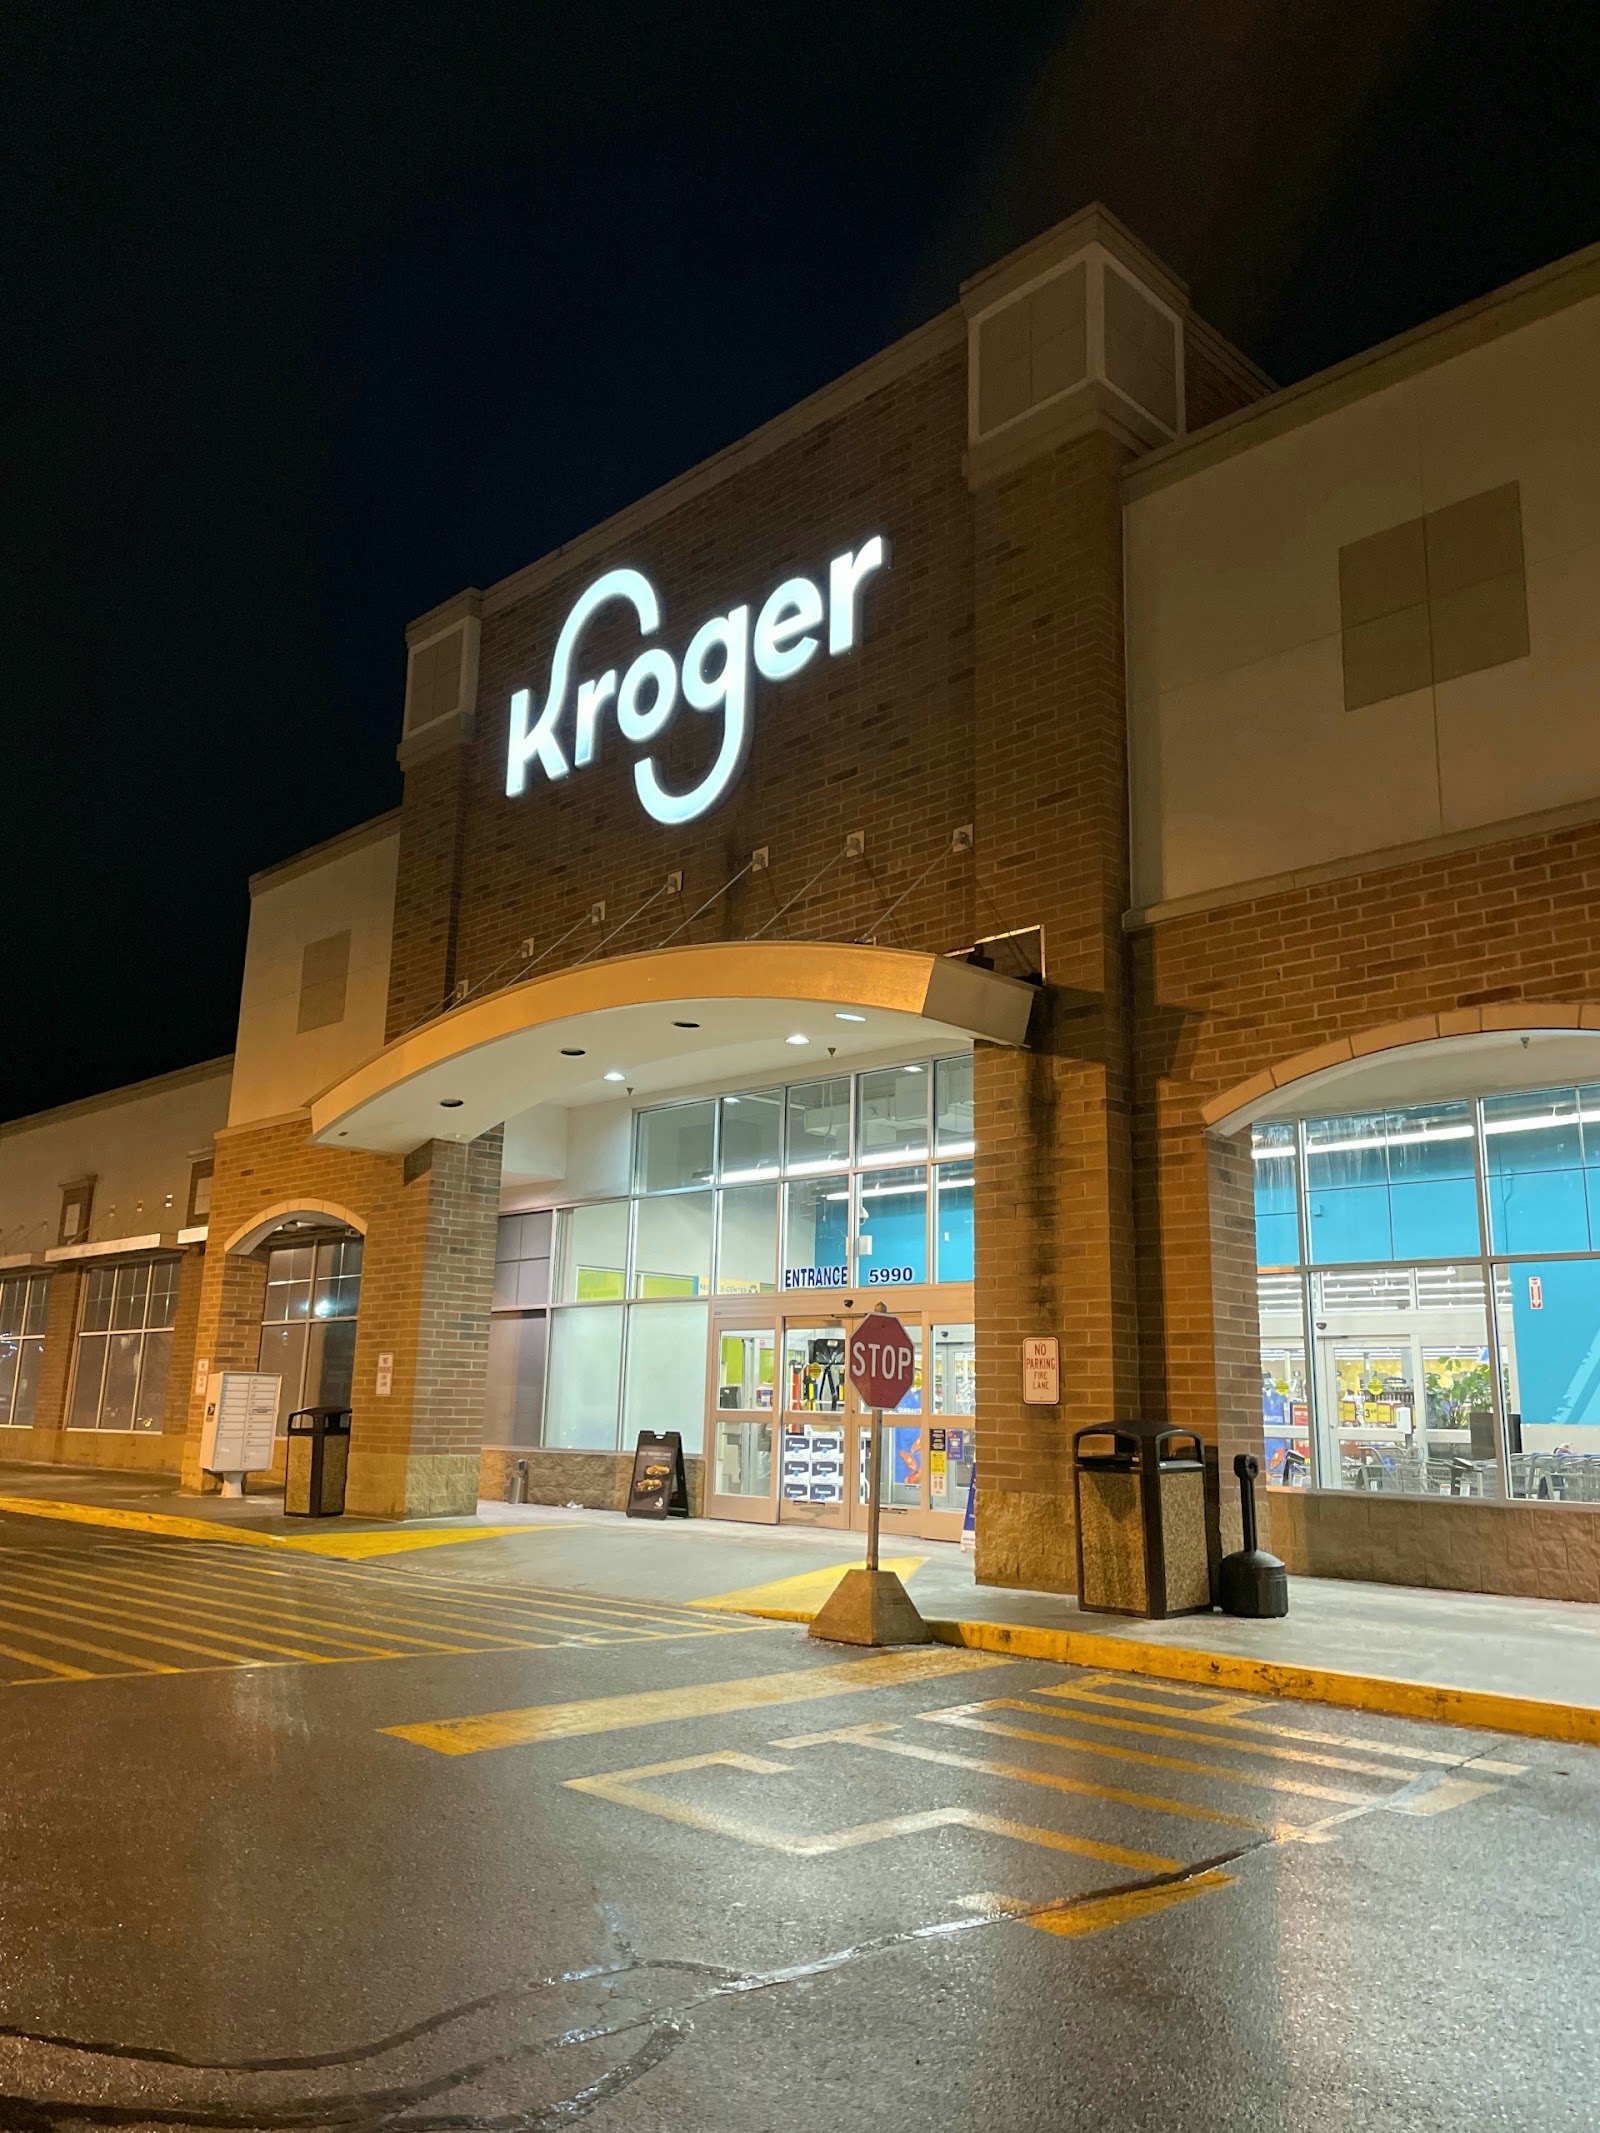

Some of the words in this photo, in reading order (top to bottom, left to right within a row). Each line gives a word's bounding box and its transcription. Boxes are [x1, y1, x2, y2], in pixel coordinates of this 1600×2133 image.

[506, 536, 883, 825] Kroger
[785, 1266, 848, 1288] ENTRANCE
[869, 1267, 913, 1283] 5990
[1034, 1344, 1047, 1356] NO
[852, 1341, 911, 1380] STOP
[1026, 1358, 1056, 1370] PARKING
[1034, 1371, 1048, 1380] FIRE
[1033, 1381, 1050, 1390] LANE
